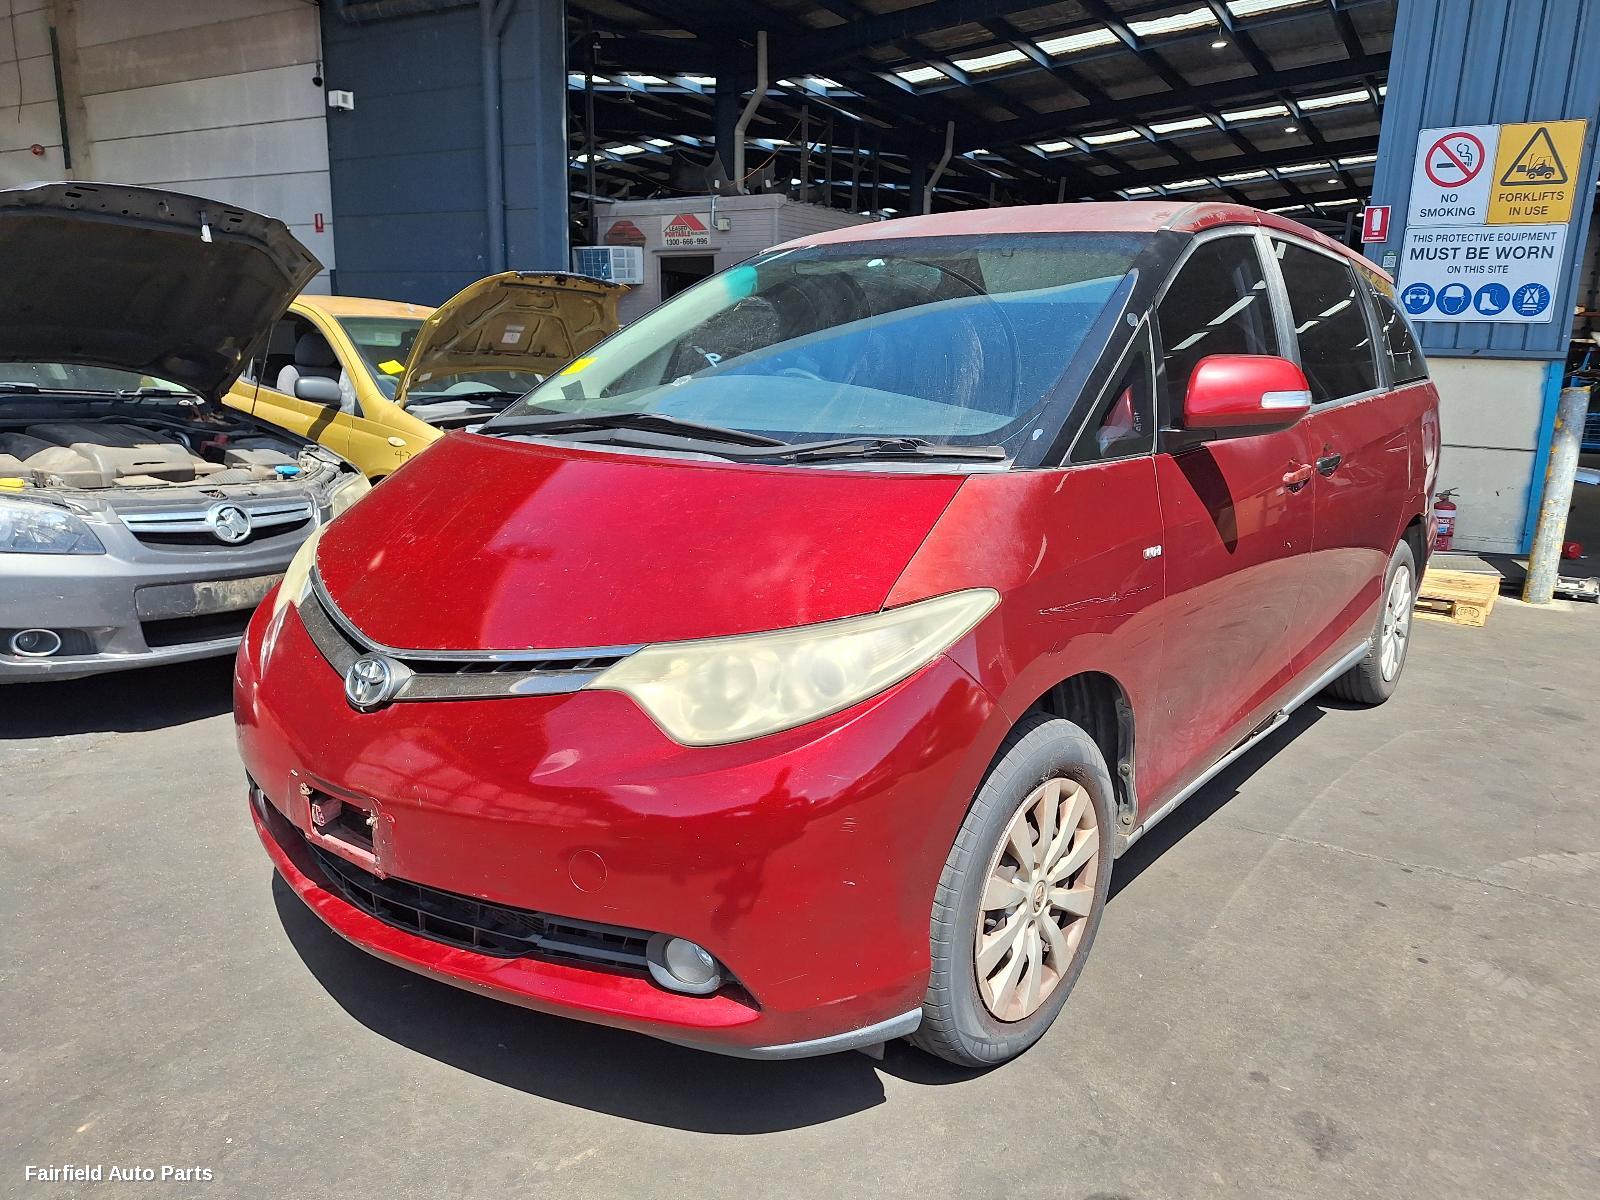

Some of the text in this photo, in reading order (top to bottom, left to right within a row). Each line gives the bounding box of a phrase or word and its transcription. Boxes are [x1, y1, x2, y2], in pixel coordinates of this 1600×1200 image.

[1440, 193, 1459, 204] NO
[1498, 191, 1565, 203] FORKLIFTS
[1419, 206, 1476, 218] SMOKING
[1508, 205, 1549, 216] IN USE
[664, 230, 691, 238] PORTABLE
[1413, 231, 1557, 243] THIS PROTECTIVE EQUIPMENT
[666, 237, 708, 246] 1300-666-996
[1409, 245, 1555, 261] MUST BE WORN
[1446, 265, 1509, 274] ON THIS SITE
